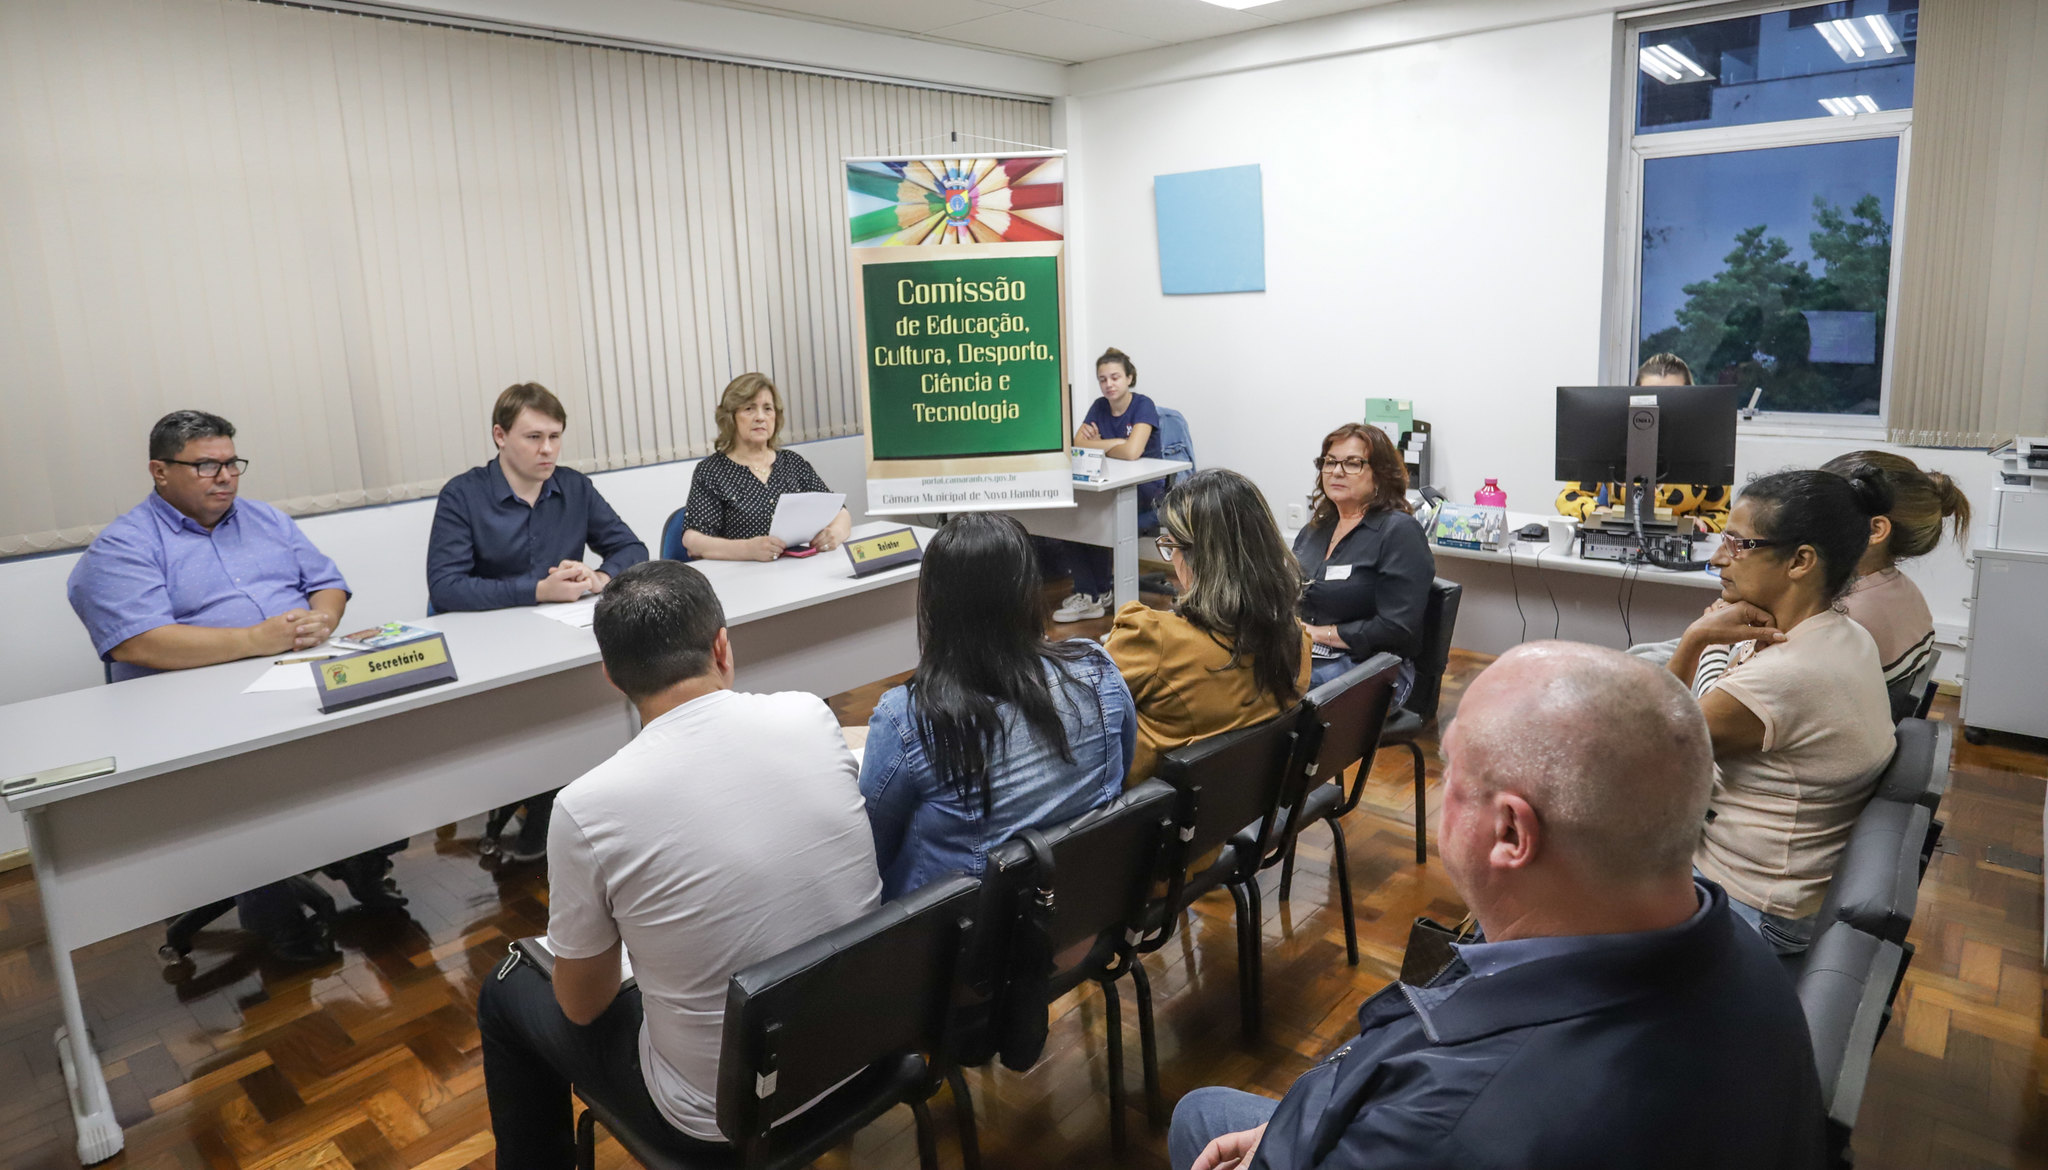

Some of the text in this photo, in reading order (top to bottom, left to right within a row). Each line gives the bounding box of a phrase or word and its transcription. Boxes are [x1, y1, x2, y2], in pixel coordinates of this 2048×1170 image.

[897, 276, 1026, 305] Comissão
[896, 313, 1030, 339] de Educação,
[874, 341, 1054, 366] Cultura, Desporto,
[921, 372, 1011, 394] Ciência e
[912, 399, 1020, 424] Tecnologia
[882, 488, 1059, 505] Câmara Municipal de Novo Hamburgo
[877, 541, 900, 552] Relator
[368, 650, 425, 673] Secretário
